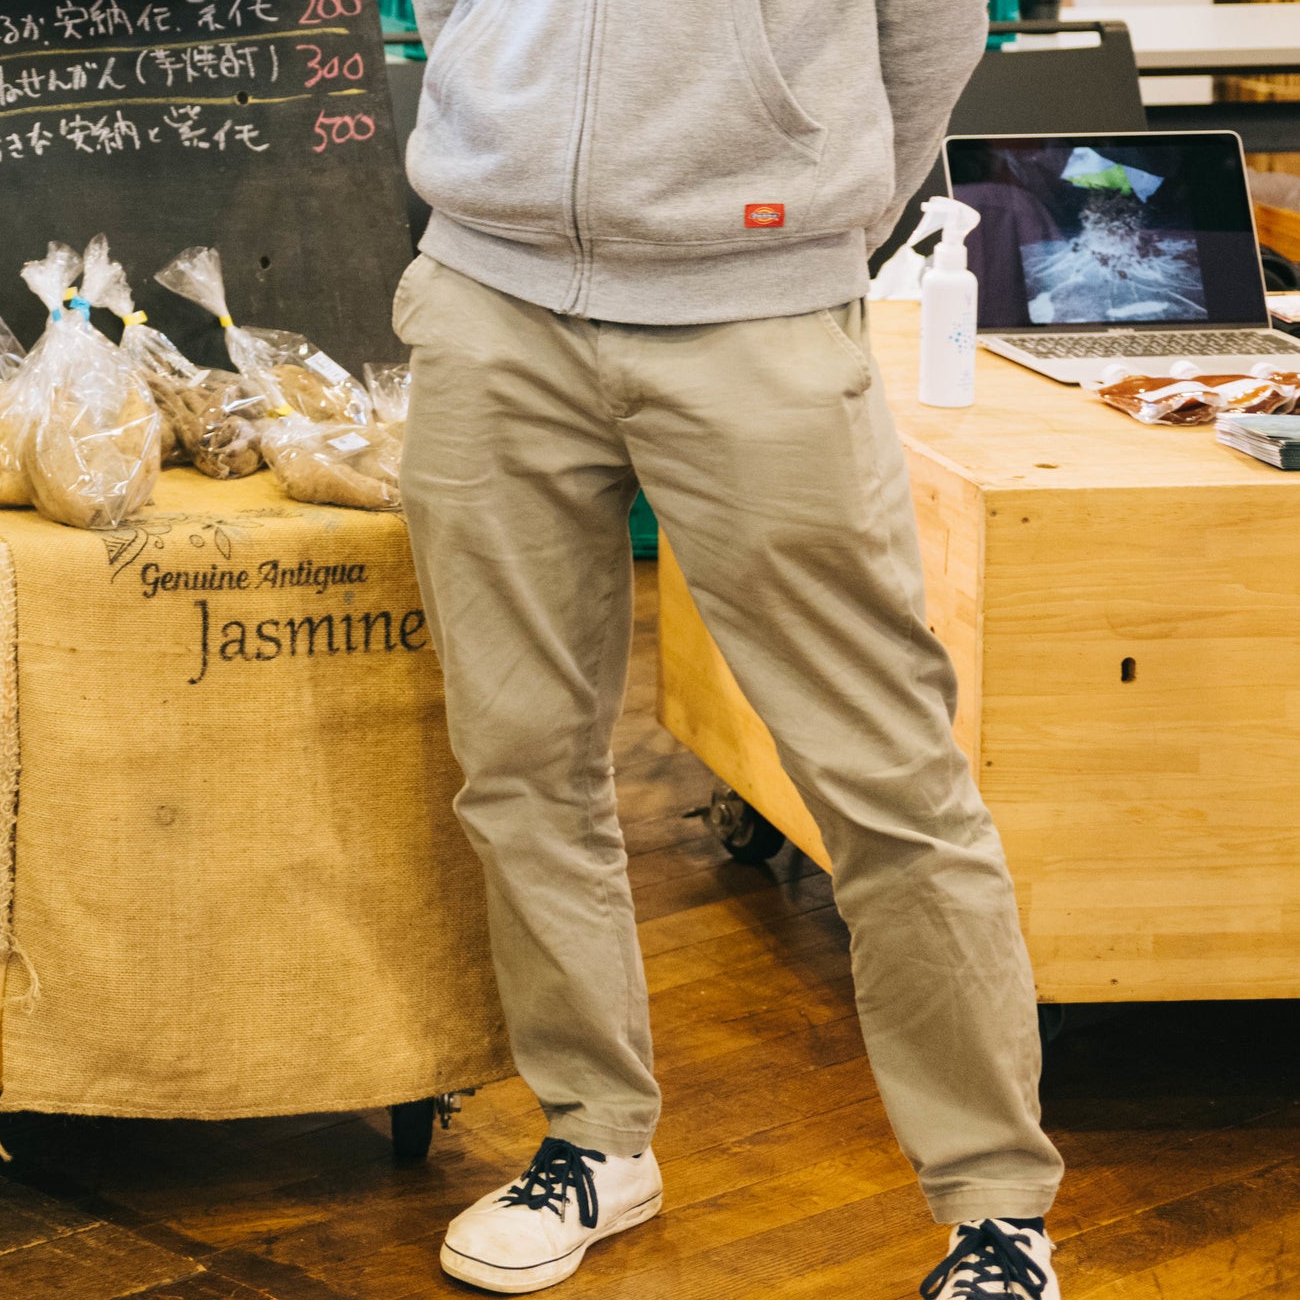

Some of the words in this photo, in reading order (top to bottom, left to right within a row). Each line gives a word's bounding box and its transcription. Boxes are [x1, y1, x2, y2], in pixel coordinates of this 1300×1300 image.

[295, 44, 365, 88] 300
[311, 109, 376, 154] 500
[139, 562, 250, 599] Genuine
[256, 558, 369, 595] Antigua
[188, 599, 429, 685] Jasmine
